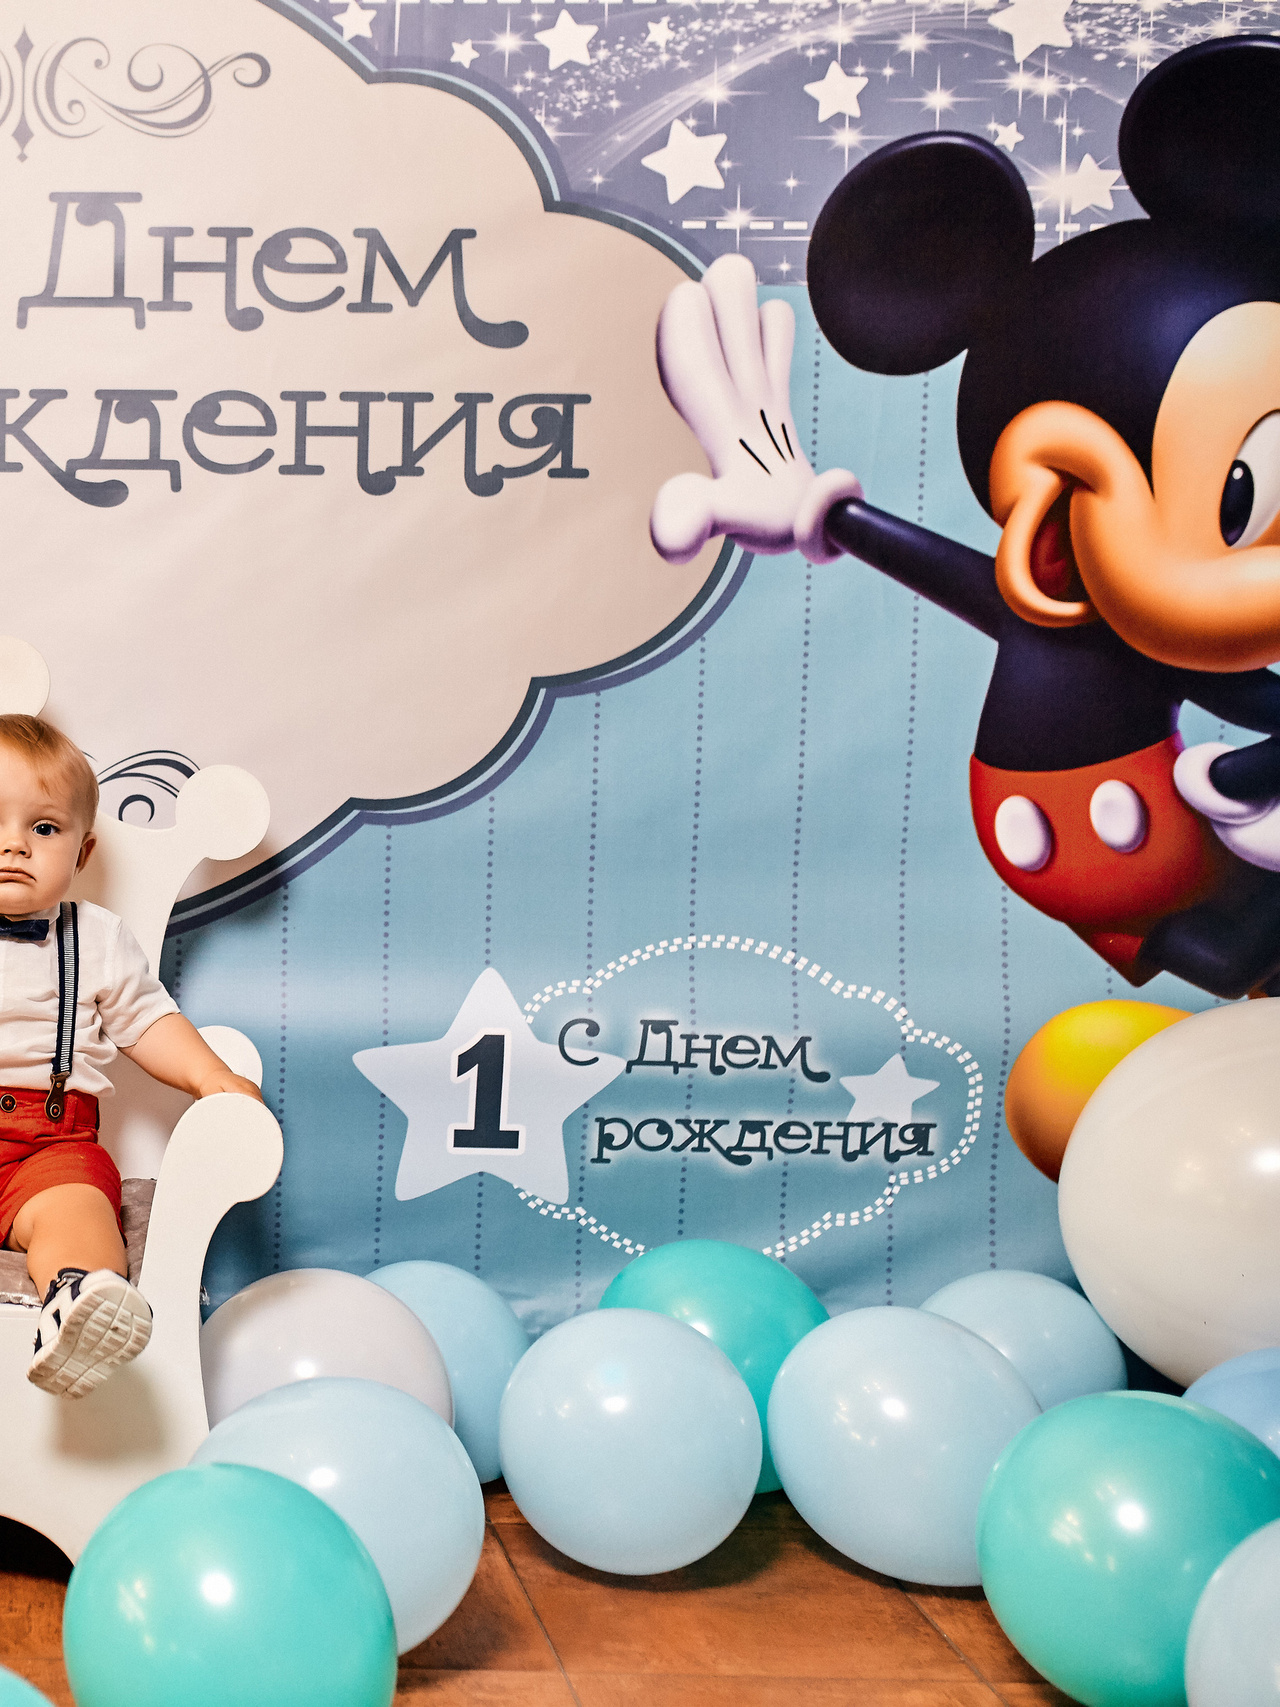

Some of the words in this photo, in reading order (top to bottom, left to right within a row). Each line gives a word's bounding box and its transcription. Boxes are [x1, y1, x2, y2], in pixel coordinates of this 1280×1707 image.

[16, 191, 530, 350] Днем
[452, 1033, 520, 1149] 1
[558, 1018, 601, 1066] С
[625, 1019, 831, 1083] Днем
[590, 1116, 938, 1166] рождения
